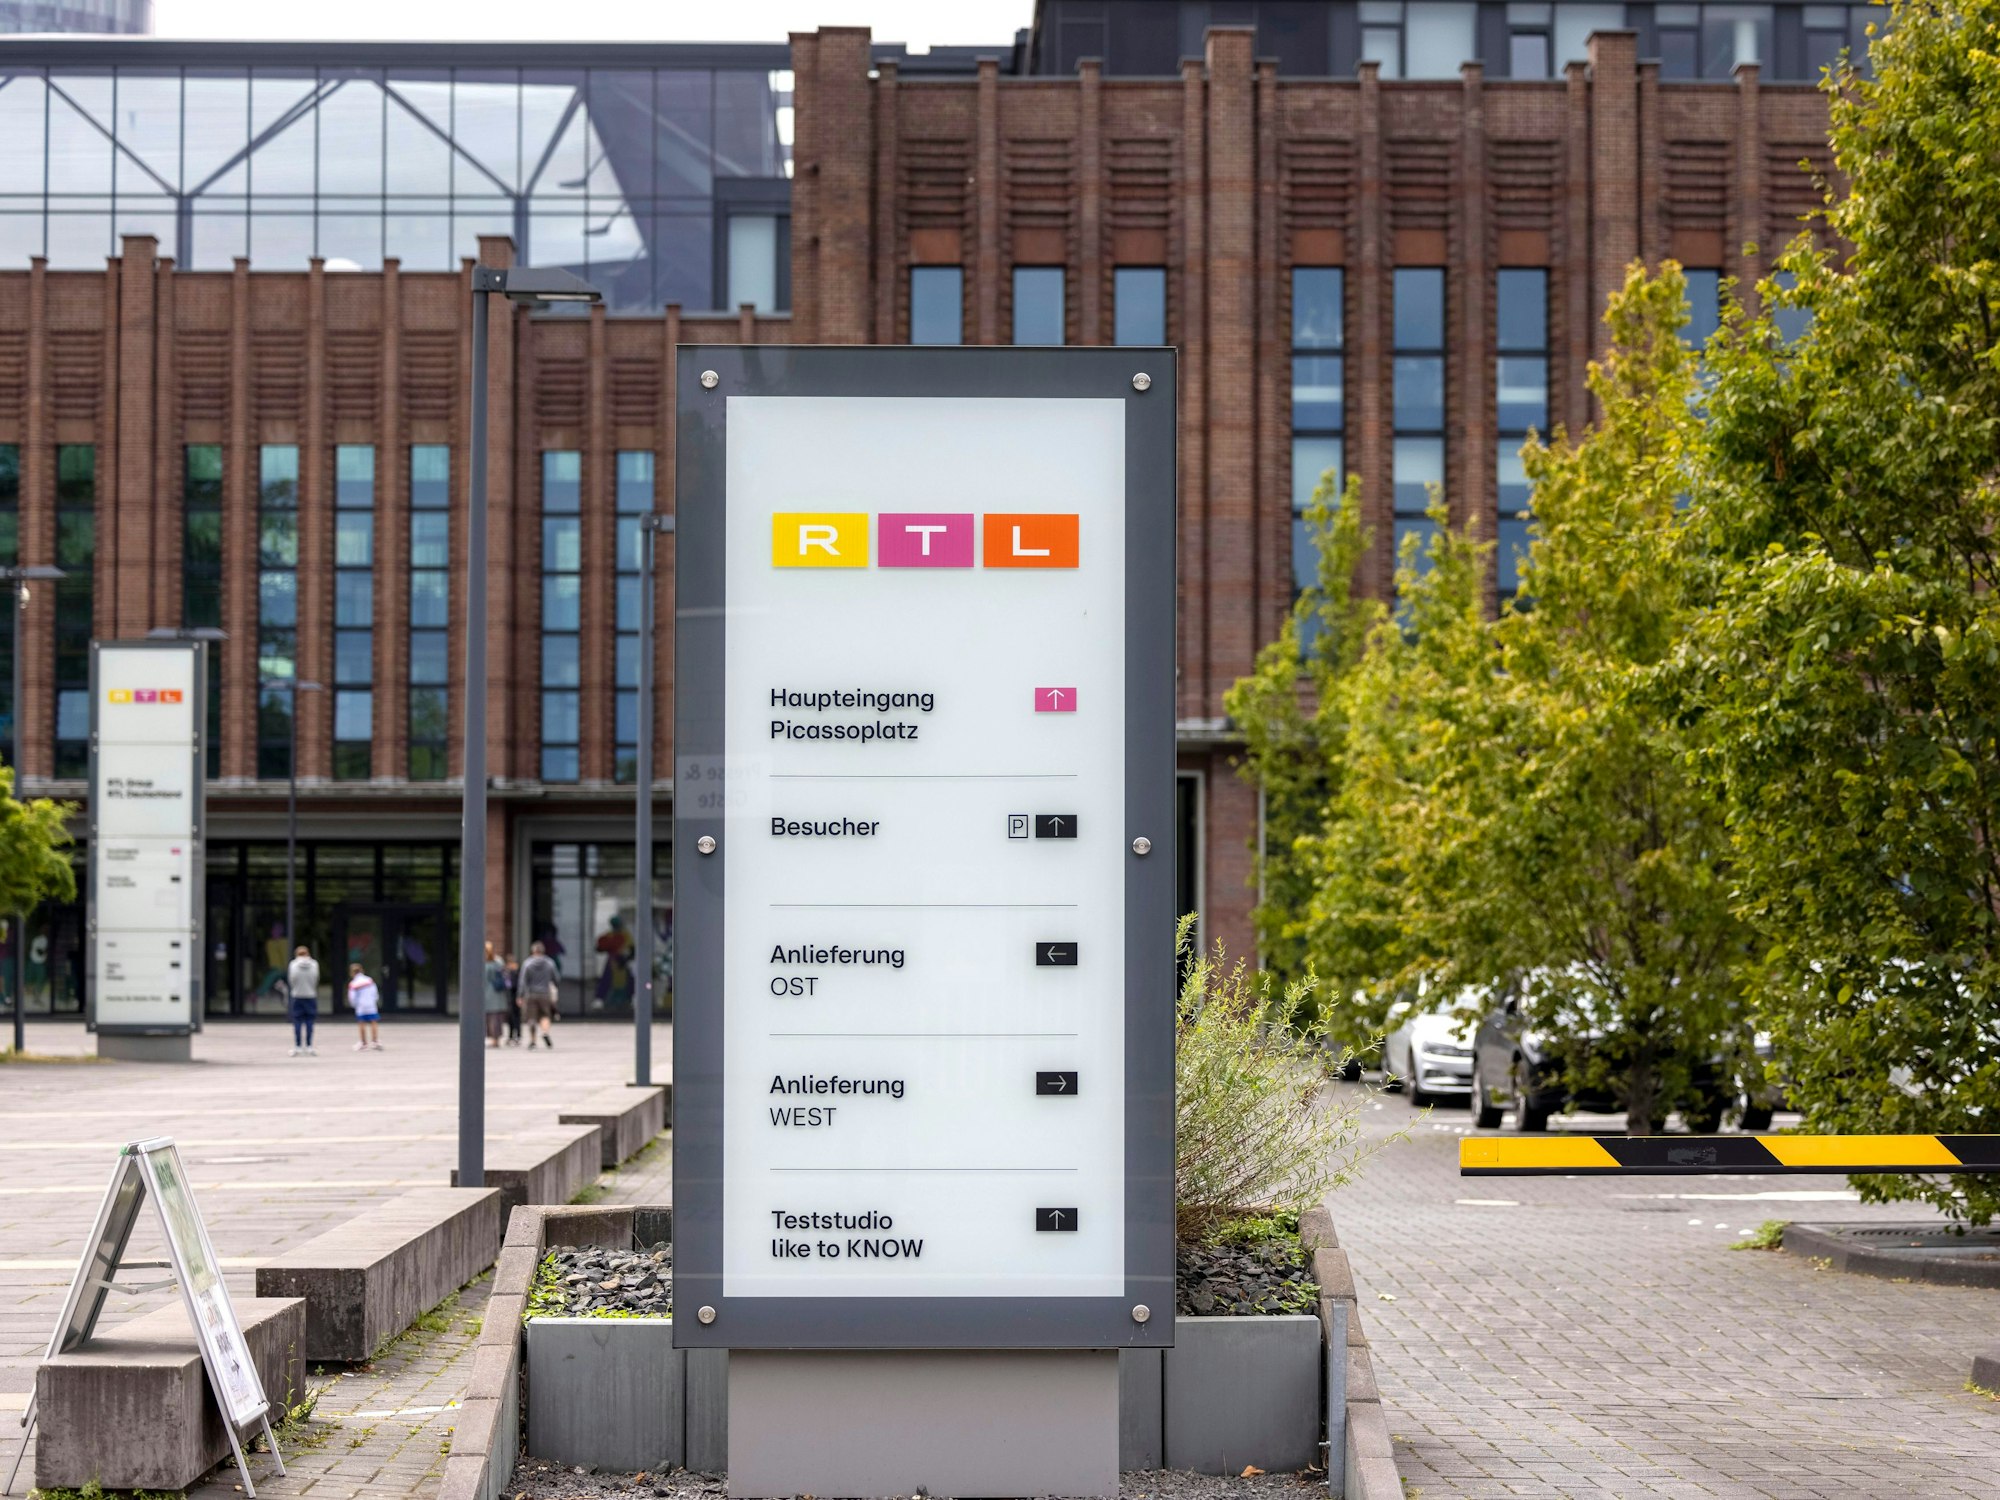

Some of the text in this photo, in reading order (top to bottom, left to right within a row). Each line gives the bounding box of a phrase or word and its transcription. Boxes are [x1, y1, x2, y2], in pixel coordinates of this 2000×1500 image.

[796, 523, 1053, 558] RTL
[770, 687, 935, 714] Haupteingang
[770, 718, 920, 745] Picassoplatz
[770, 816, 881, 837] Besucher
[1011, 817, 1026, 836] P
[769, 943, 906, 970] Anlieferung
[769, 975, 820, 997] OST
[769, 1073, 906, 1100] Anlieferung
[769, 1106, 838, 1128] WEST
[771, 1209, 894, 1231] Teststudio
[771, 1237, 925, 1259] like to KNOW
